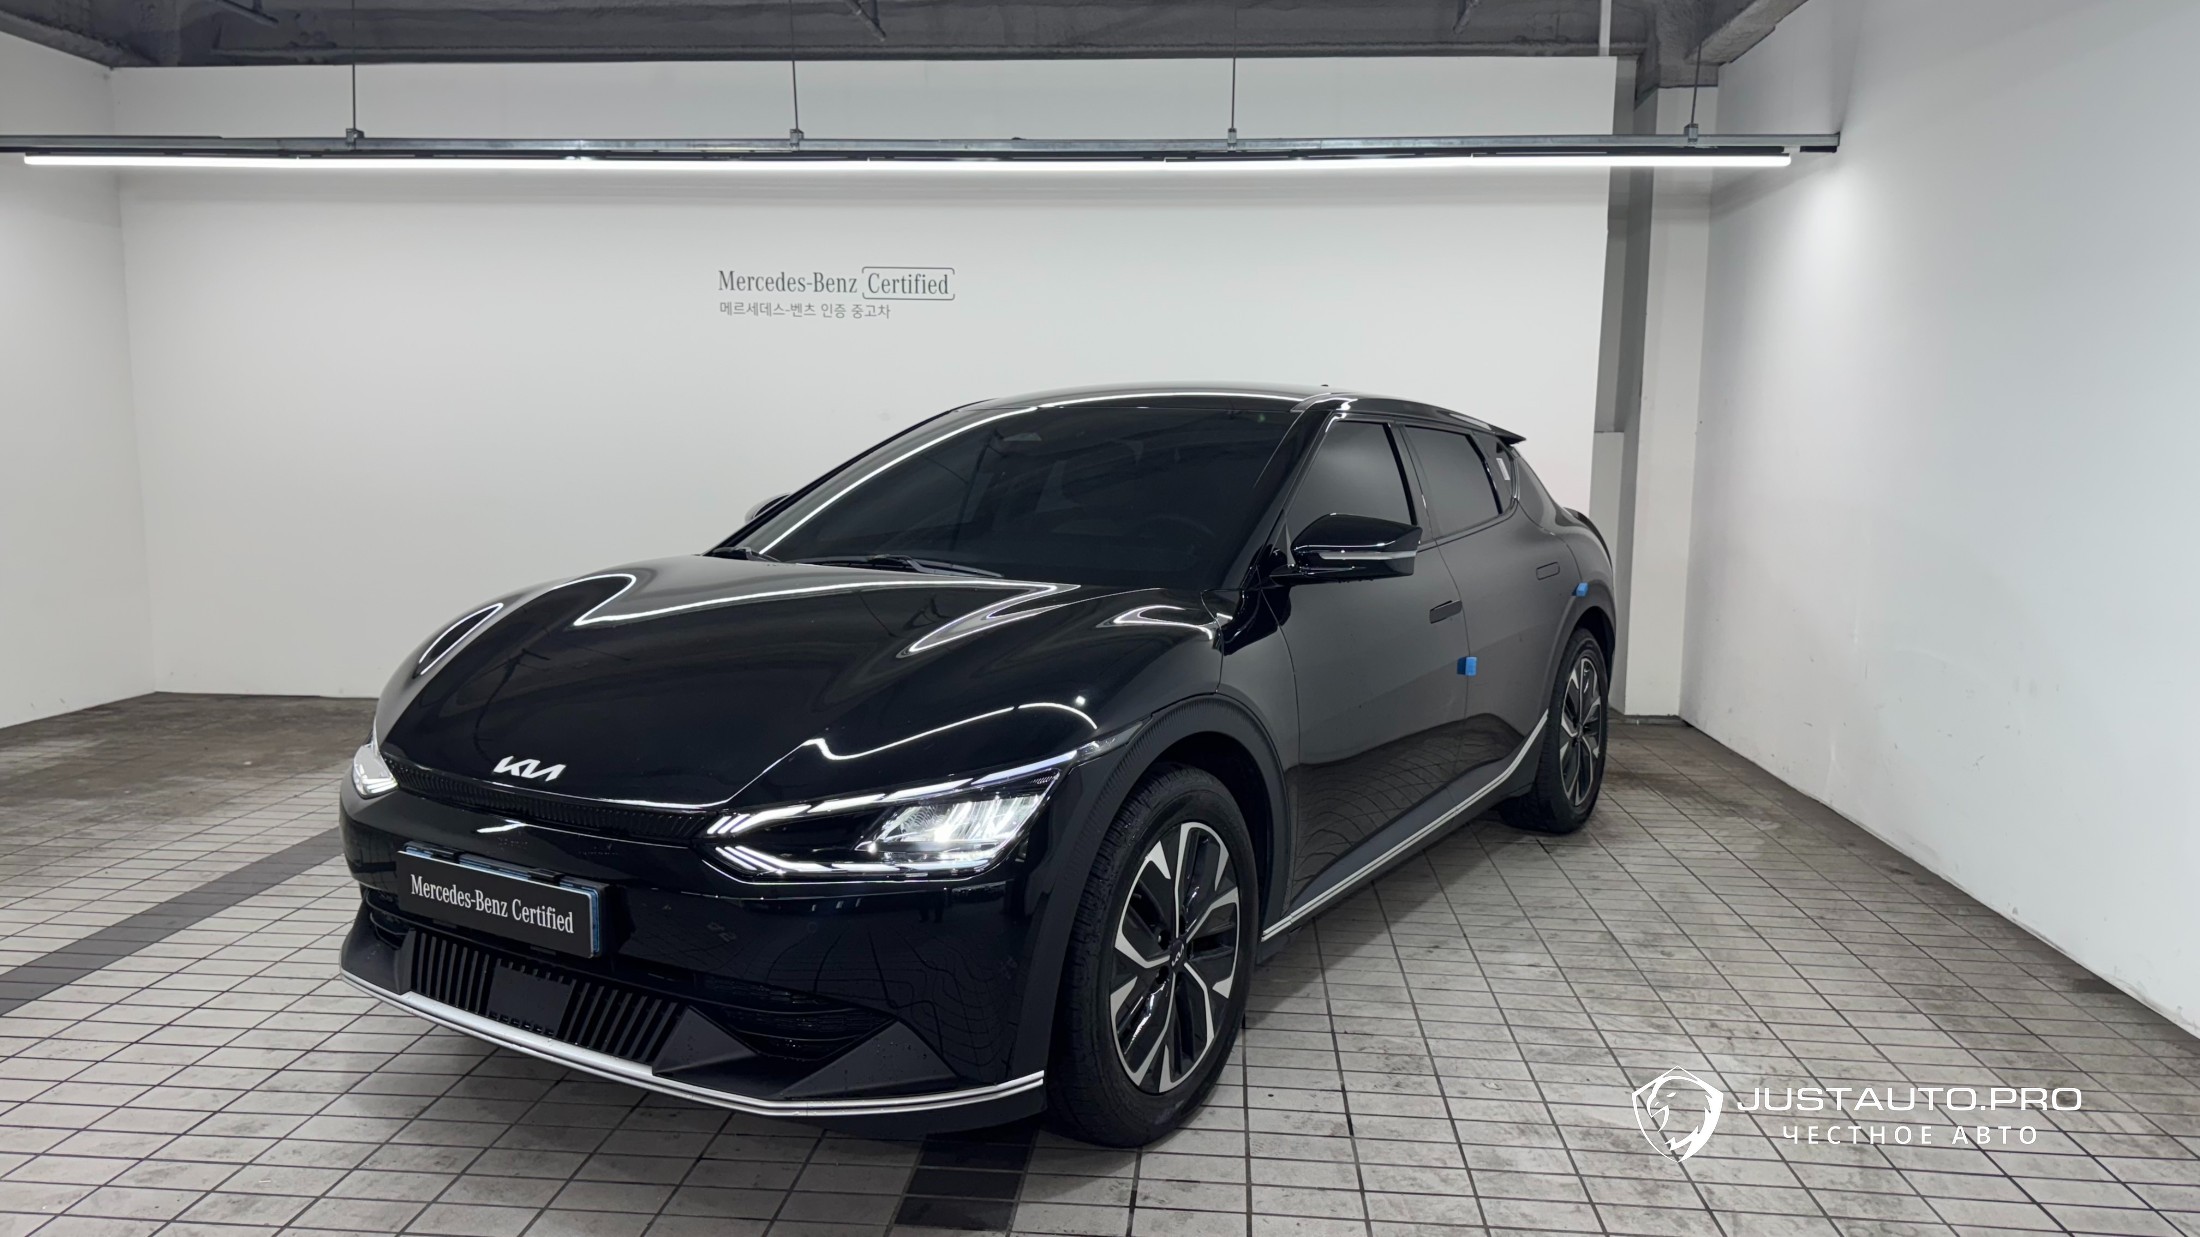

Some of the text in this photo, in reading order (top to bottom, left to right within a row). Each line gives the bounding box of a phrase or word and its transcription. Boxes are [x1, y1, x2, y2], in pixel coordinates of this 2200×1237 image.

[718, 270, 949, 295] Mercedes-Benz Certified
[719, 301, 891, 320] 메르세데스-벤츠 인증 중고차
[410, 873, 574, 934] Mercedes-Benz Certified
